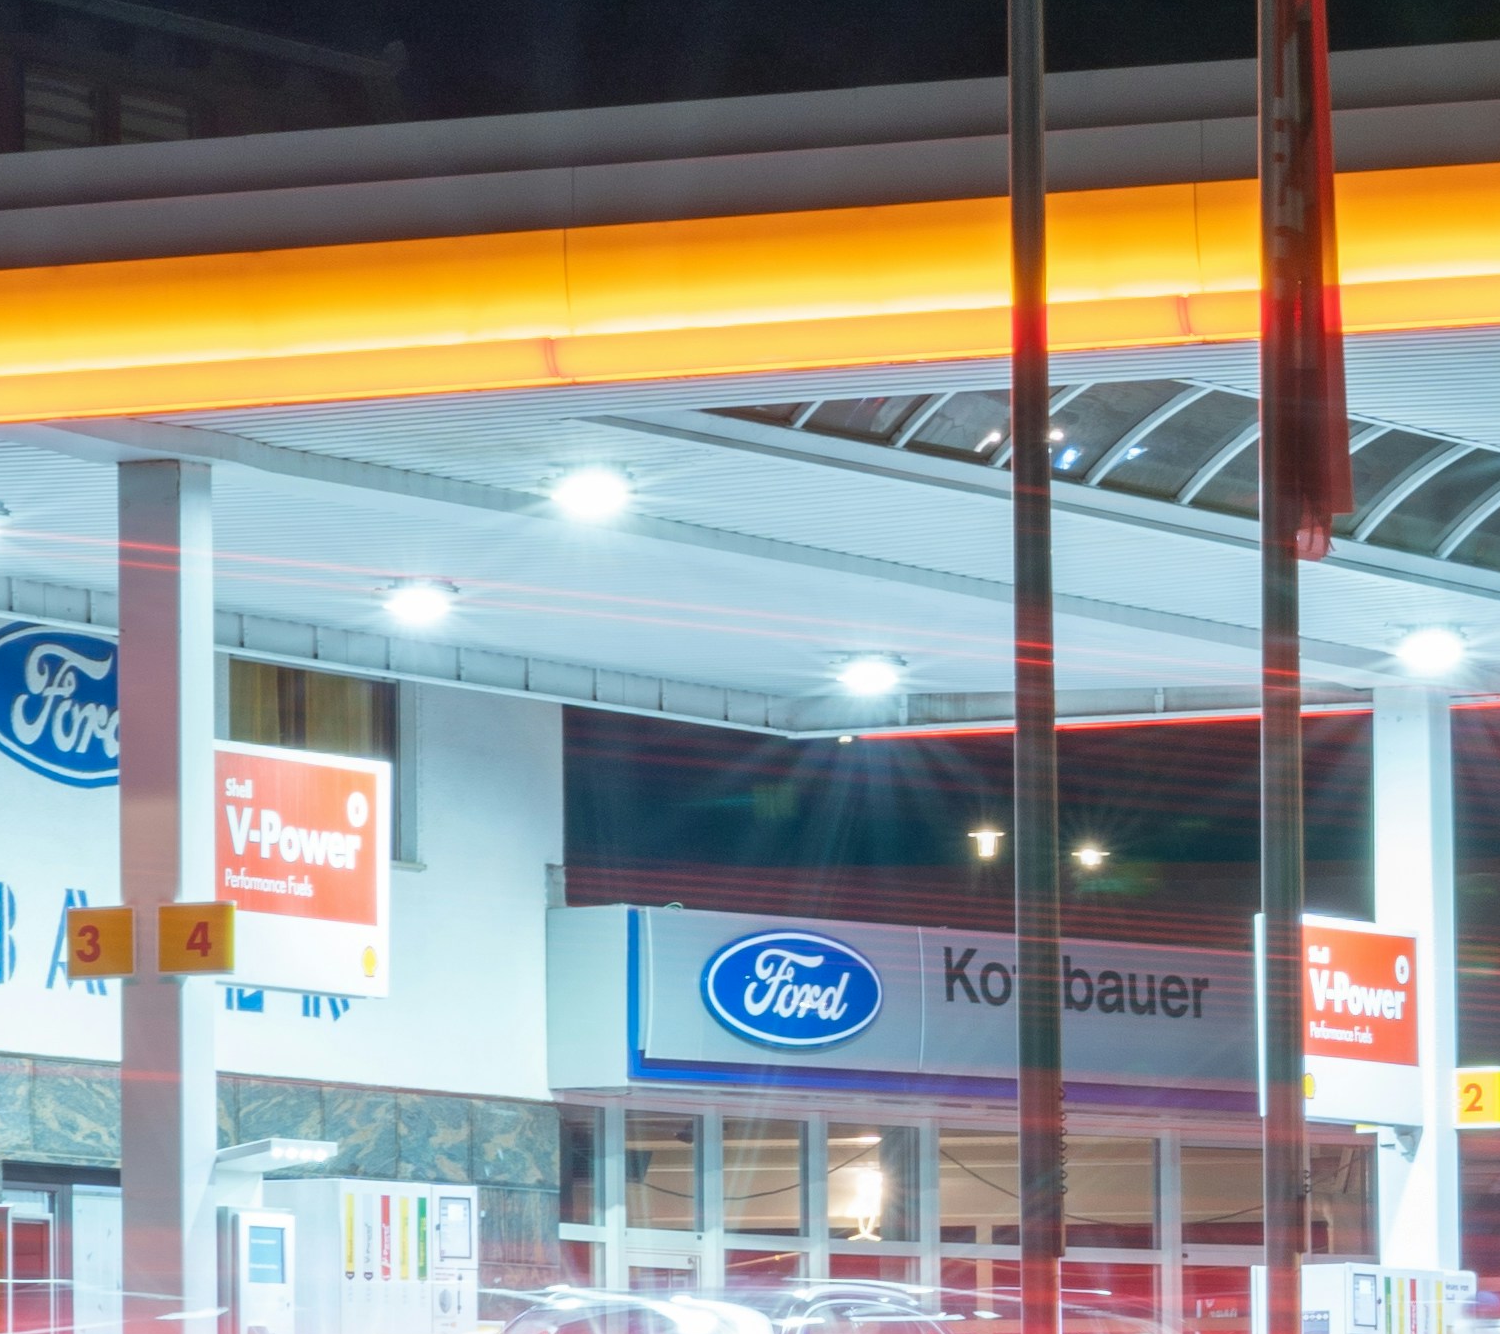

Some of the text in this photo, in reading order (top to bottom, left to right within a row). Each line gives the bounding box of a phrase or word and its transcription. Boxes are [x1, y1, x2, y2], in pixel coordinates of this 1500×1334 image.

[225, 777, 253, 799] Shell
[225, 804, 362, 871] V-Power
[224, 867, 314, 898] Performance Fuels
[75, 925, 101, 963] 3
[186, 921, 212, 957] 4
[744, 947, 850, 1022] Ford
[942, 944, 1210, 1019] Kobauer
[1308, 968, 1406, 1020] V-Power
[1463, 1082, 1483, 1112] 2
